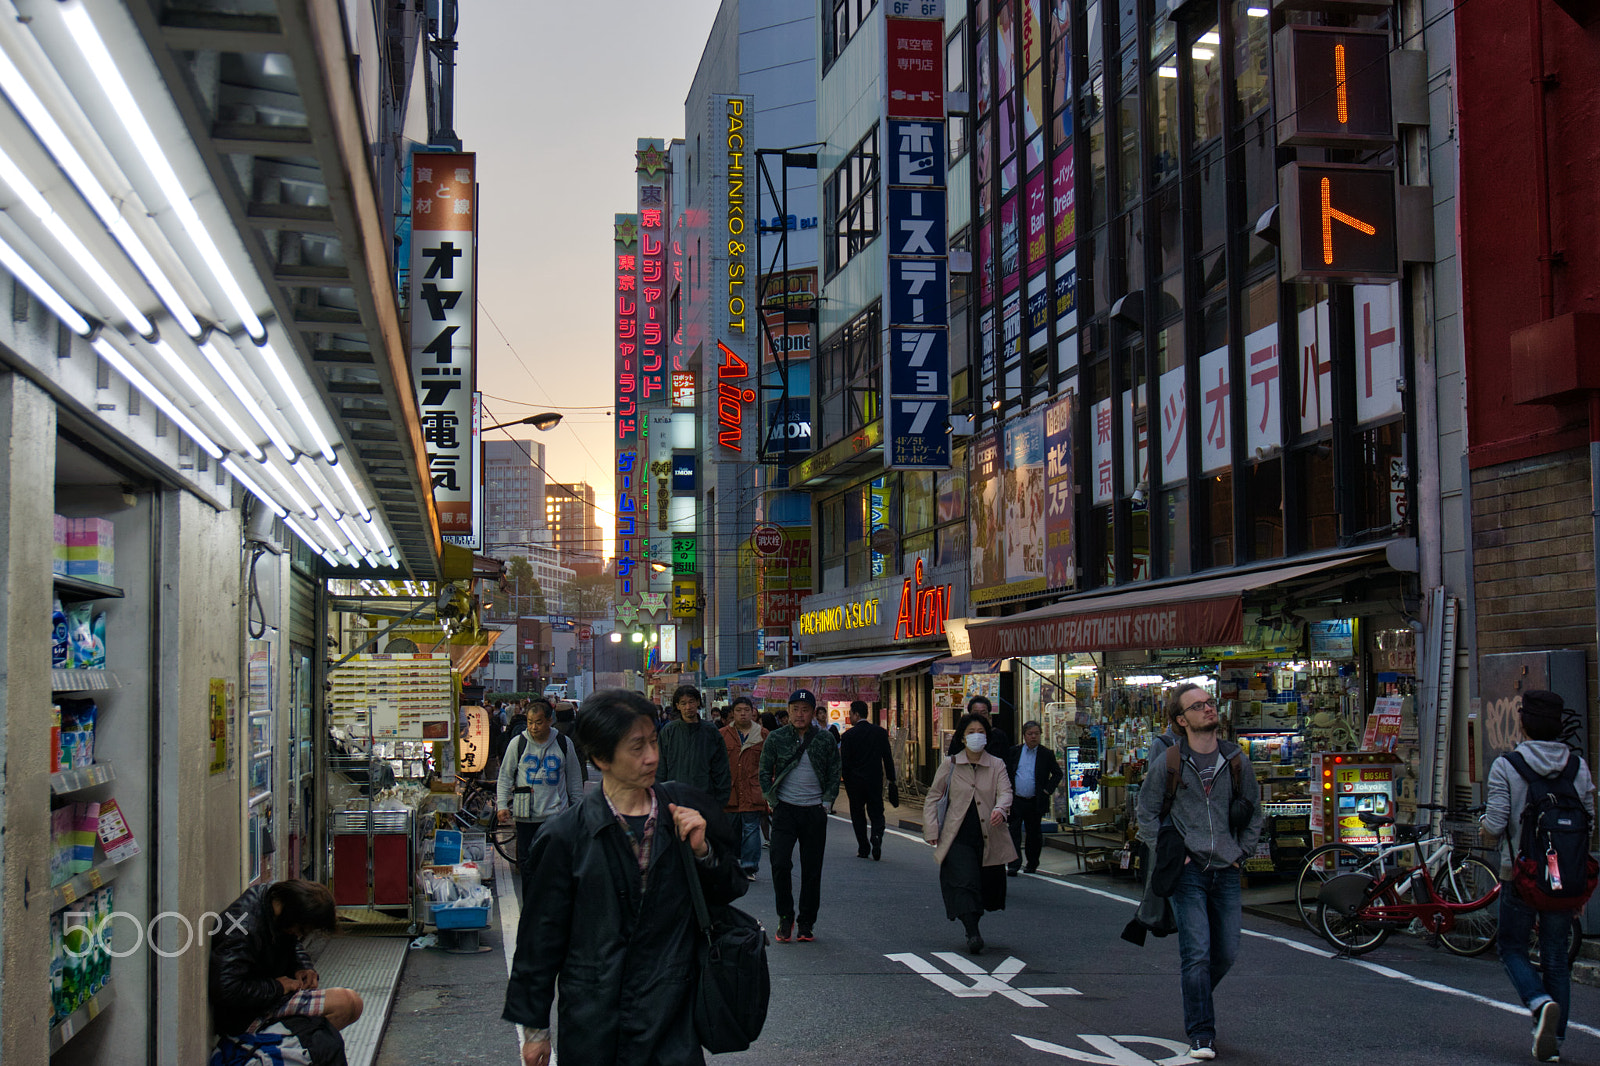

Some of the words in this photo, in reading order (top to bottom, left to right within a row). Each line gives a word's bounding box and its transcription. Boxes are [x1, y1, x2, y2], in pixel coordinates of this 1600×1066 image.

[894, 1, 909, 14] 6F
[921, 4, 936, 16] 6F
[897, 38, 933, 51] 真空管
[897, 58, 933, 71] 専門店
[728, 99, 744, 235] PACHINKO
[728, 240, 746, 256] &
[898, 123, 937, 434] ホビーステーション
[641, 185, 661, 398] 東京レジャーランド
[728, 263, 746, 333] SLOT
[618, 255, 636, 438] 東京レジャーランド
[421, 241, 463, 491] オヤイデ電気
[895, 445, 946, 455] カードゲーム
[441, 512, 468, 524] 販売
[618, 452, 637, 593] ゲームコーナー
[674, 540, 695, 552] ネジ
[758, 535, 781, 546] 消火栓
[680, 552, 688, 560] の
[674, 562, 695, 572] 西川
[799, 605, 842, 636] PACHINKO
[852, 598, 879, 629] SLOT
[998, 626, 1028, 653] TOKYO
[1029, 624, 1055, 651] RADIO
[1056, 615, 1133, 649] DEPARTMENT
[1134, 610, 1177, 641] STORE
[1380, 715, 1401, 726] MOBILE
[523, 754, 561, 786] 28
[1341, 771, 1354, 781] 1F
[1363, 772, 1374, 780] BIG
[1374, 772, 1390, 780] SALE
[1355, 783, 1377, 792] Tokyo
